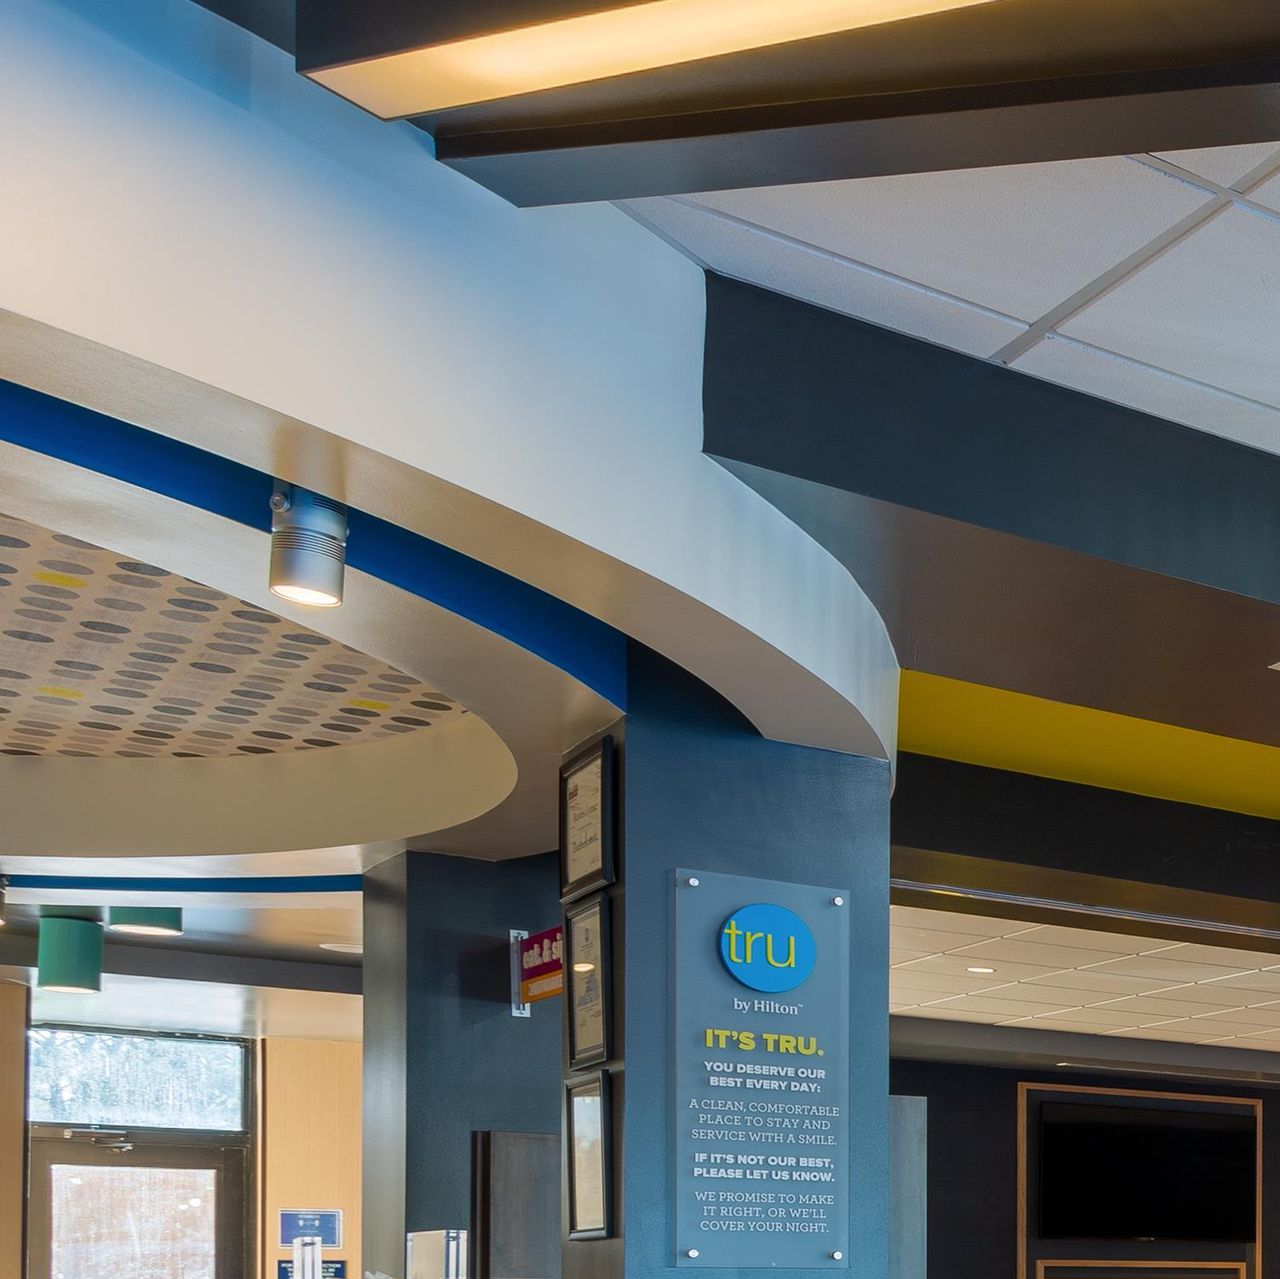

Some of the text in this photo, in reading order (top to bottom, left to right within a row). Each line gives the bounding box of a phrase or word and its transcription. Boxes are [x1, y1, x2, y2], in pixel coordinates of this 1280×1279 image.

[724, 920, 795, 968] tru
[733, 998, 799, 1015] by Hilton
[762, 1033, 824, 1056] TRU.
[704, 1061, 826, 1079] YOU DESERVE OUR
[709, 1077, 821, 1092] BEST EVERY DAY:
[689, 1099, 840, 1117] A CLEAN, COMFORTABLE
[698, 1114, 831, 1130] PLACE TO STAY AND
[691, 1129, 838, 1146] SERVICE WITH A SMILE.
[694, 1153, 707, 1163] IF
[738, 1155, 765, 1165] NOT
[768, 1156, 796, 1166] OUR
[799, 1157, 834, 1169] BEST,
[694, 1168, 835, 1182] PLEASE LET US KNOW.
[694, 1191, 834, 1205] WE PROMISE TO MAKE
[703, 1206, 717, 1216] IT
[720, 1207, 765, 1218] RIGHT,
[768, 1208, 786, 1218] OR
[700, 1221, 829, 1233] COVER YOUR NIGHT.
